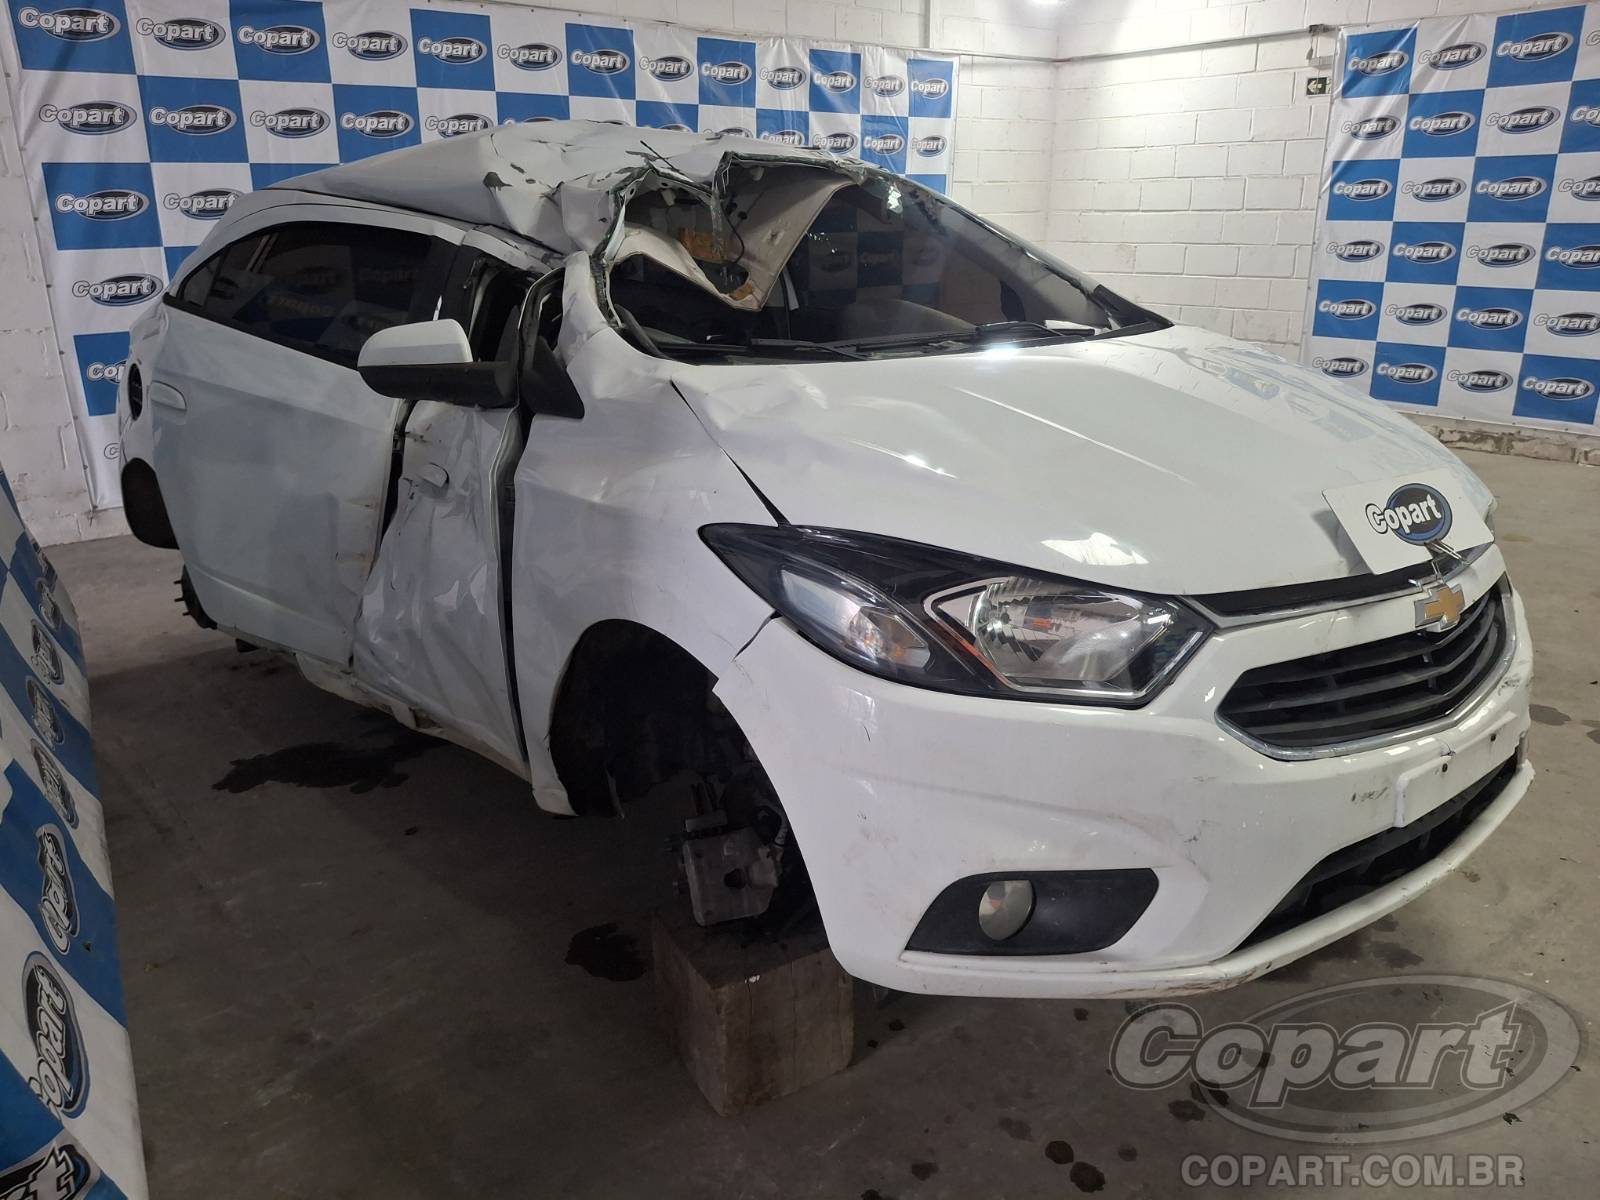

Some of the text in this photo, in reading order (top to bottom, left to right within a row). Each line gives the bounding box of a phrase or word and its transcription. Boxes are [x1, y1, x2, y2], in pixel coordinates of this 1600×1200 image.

[18, 7, 109, 35] Copart
[136, 18, 214, 41] Copart
[238, 25, 311, 48] Copart
[332, 31, 399, 53] Copart
[1496, 33, 1563, 57] Copart
[416, 38, 480, 57] Copart
[497, 43, 553, 63] Copart
[1418, 45, 1478, 65] Copart
[570, 50, 624, 69] Copart
[639, 56, 688, 73] Copart
[1348, 53, 1401, 71] Copart
[700, 62, 746, 80] Copart
[760, 69, 800, 85] Copart
[814, 72, 852, 88] Copart
[911, 79, 946, 94] Copart
[39, 104, 125, 129] Copart
[149, 106, 228, 129] Copart
[250, 110, 320, 131] Copart
[340, 112, 406, 133] Copart
[425, 115, 485, 135] Copart
[1409, 114, 1470, 133] Copart
[1485, 109, 1550, 128] Copart
[1341, 118, 1396, 136] Copart
[863, 136, 902, 152] Copart
[1332, 180, 1388, 197] Copart
[1400, 180, 1461, 198] Copart
[1475, 179, 1542, 197] Copart
[55, 192, 139, 216] Copart
[1326, 241, 1378, 257] Copart
[1392, 243, 1449, 259] Copart
[1466, 245, 1526, 262] Copart
[1545, 246, 1600, 265] Copar
[71, 277, 153, 300] Copart
[1318, 300, 1370, 316] Copart
[1385, 302, 1440, 319] Copart
[1455, 308, 1516, 326] Copart
[1533, 313, 1599, 331] Copart
[1311, 356, 1362, 373] Copart
[1375, 362, 1434, 381] Copart
[1446, 369, 1507, 388] Copart
[1521, 376, 1586, 396] Copart
[1365, 493, 1442, 534] Copart
